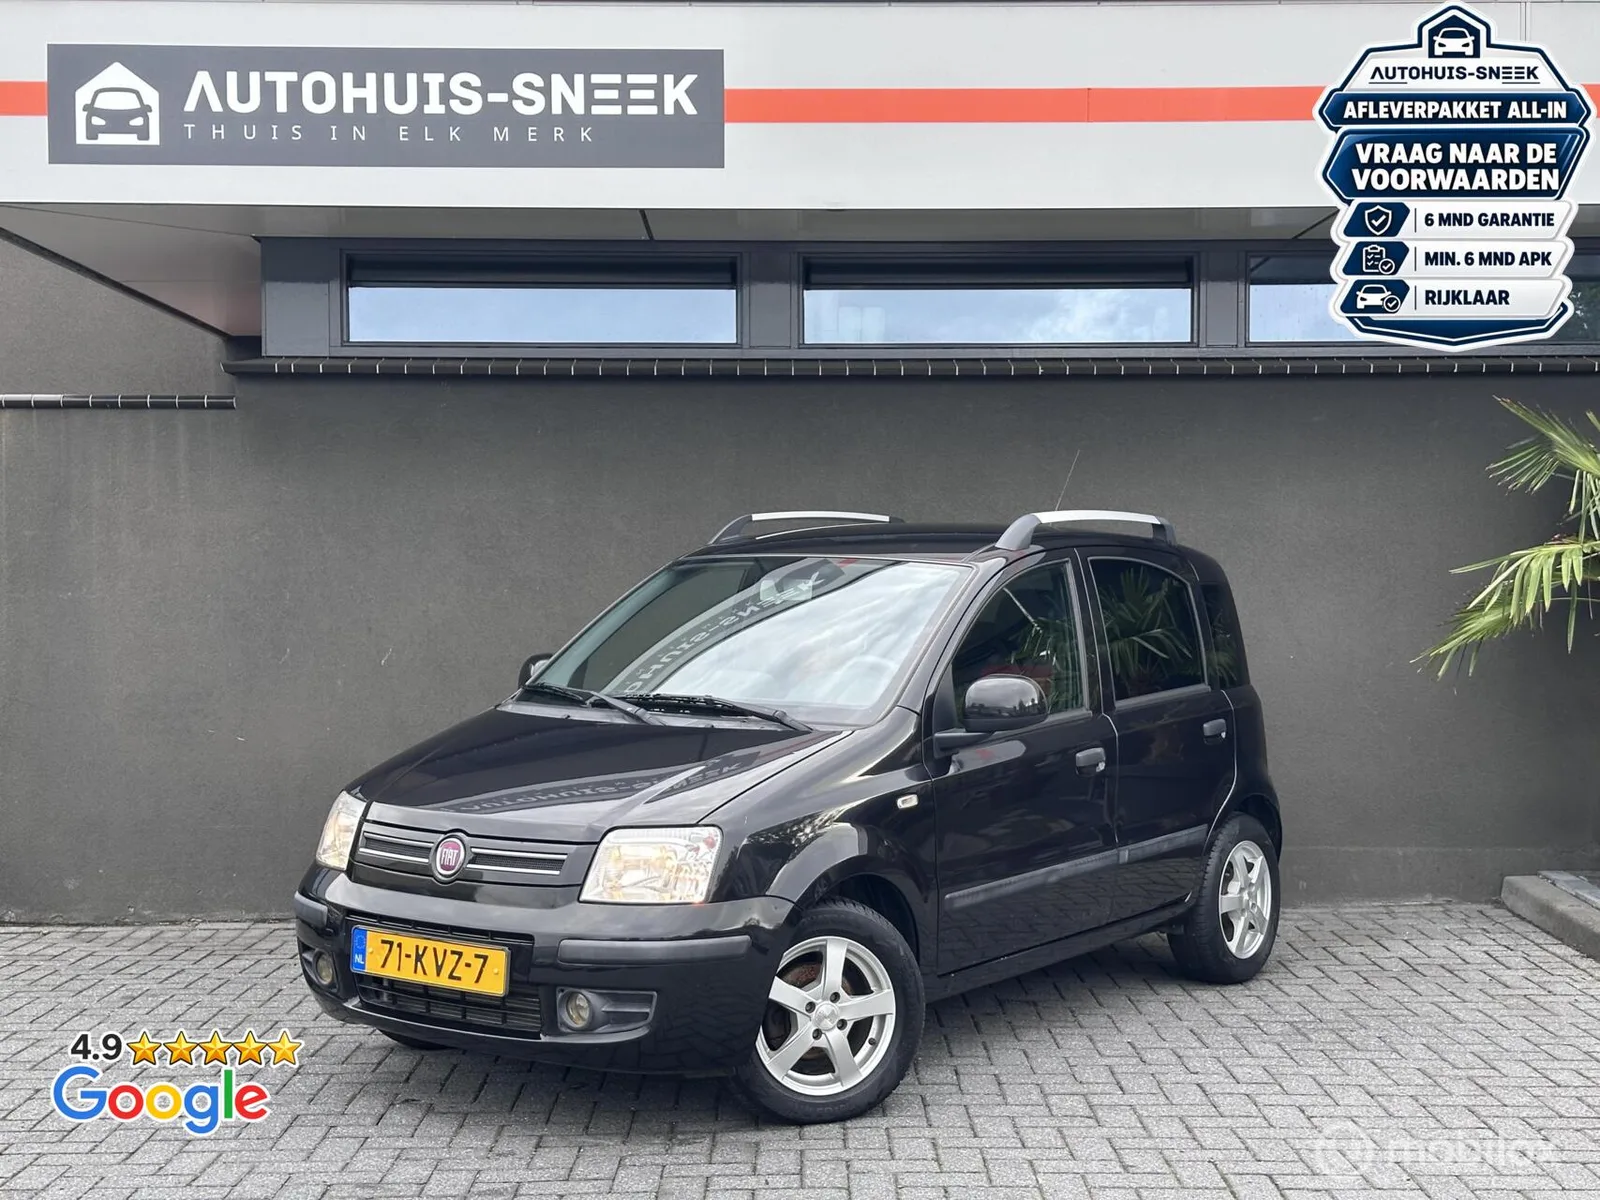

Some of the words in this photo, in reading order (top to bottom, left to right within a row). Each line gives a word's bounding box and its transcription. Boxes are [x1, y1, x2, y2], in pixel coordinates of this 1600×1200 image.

[183, 70, 699, 117] AUTOHUIS-SNEEK
[184, 123, 304, 141] THUIS
[331, 125, 367, 142] IN
[399, 126, 462, 143] ELK
[494, 127, 595, 143] MERK
[440, 847, 460, 866] FIAT
[354, 953, 365, 965] NL
[380, 939, 489, 984] 71-KVZ-7
